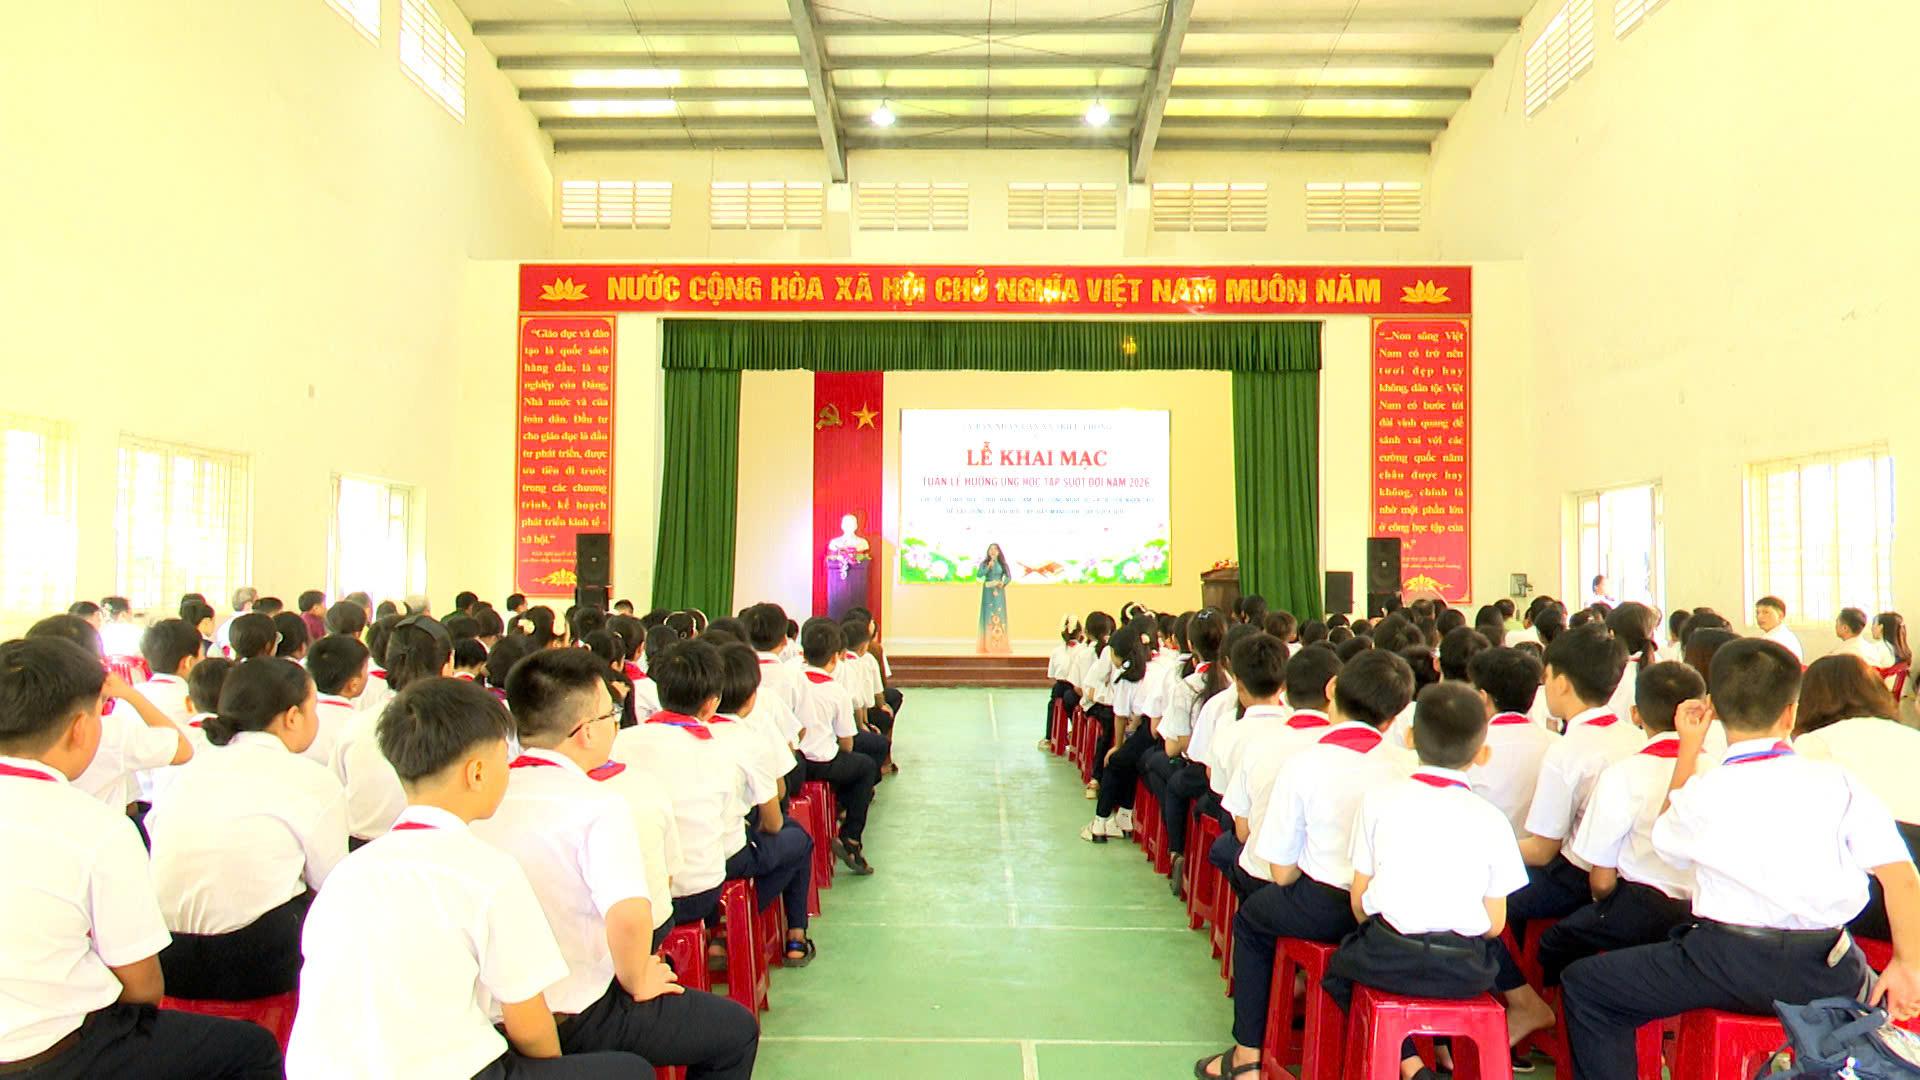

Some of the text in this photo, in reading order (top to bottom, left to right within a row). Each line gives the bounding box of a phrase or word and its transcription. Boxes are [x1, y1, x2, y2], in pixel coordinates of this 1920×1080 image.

[607, 269, 1381, 307] NƯỚC CỘNG HÒA XÃ HỘI CHỦ NGHĨA VIỆT NAM MUÔN NĂM
[531, 329, 609, 340] “Giáo dục và đào
[1418, 332, 1438, 342] sông
[1445, 331, 1463, 342] Việt
[525, 344, 608, 357] tạo là quốc sách
[1380, 348, 1463, 358] Nam có trở nên
[525, 361, 608, 374] hàng đầu, là sự
[1379, 366, 1463, 377] tươi đẹp hay
[525, 380, 608, 391] nghiệp của Đảng,
[1379, 384, 1463, 394] không, dân tộc Việt
[525, 397, 608, 406] Nhà nước và của
[1380, 401, 1463, 410] Nam có bước tới
[524, 414, 543, 423] toàn
[549, 414, 567, 423] dân.
[574, 412, 592, 423] Đầu
[1379, 416, 1463, 429] đài vinh quang để
[523, 430, 607, 443] cho giáo dục là đầu
[1380, 435, 1462, 444] sánh vai với các
[967, 441, 1107, 470] LỄ KHAI MẠC
[1379, 451, 1463, 464] cường quốc năm
[1379, 470, 1463, 481] châu được hay
[1129, 478, 1150, 487] 2026
[1379, 488, 1463, 498] không, chính là
[1380, 504, 1463, 515] nhờ một phần lớn
[1379, 524, 1463, 533] ở công học tập của
